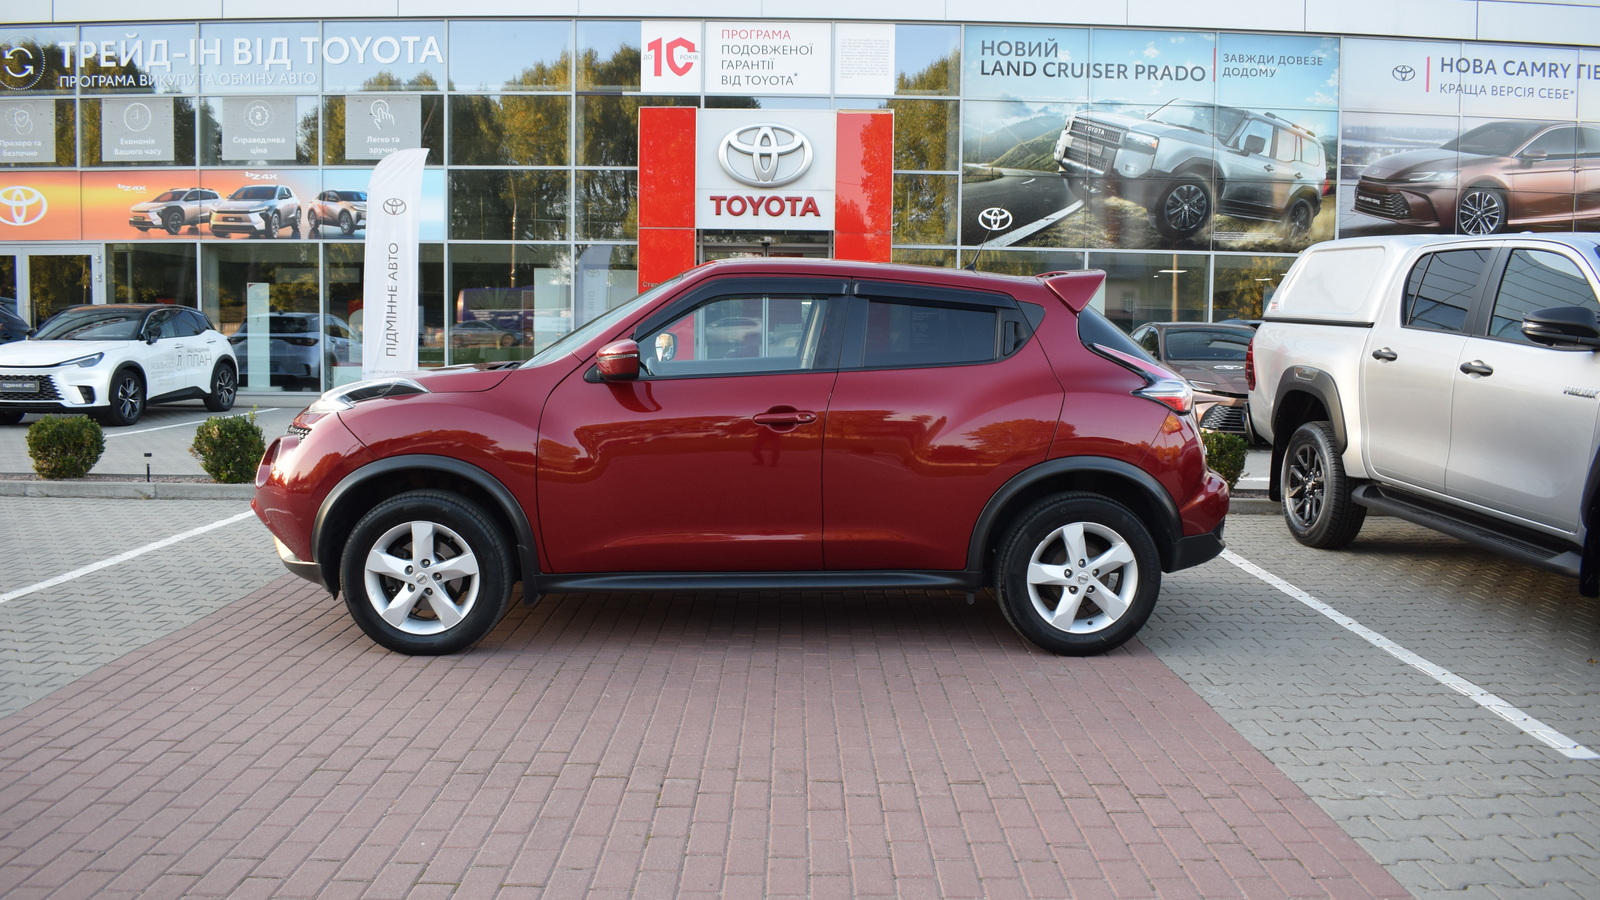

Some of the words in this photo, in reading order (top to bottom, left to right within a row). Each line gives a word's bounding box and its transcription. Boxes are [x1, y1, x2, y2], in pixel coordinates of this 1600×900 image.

[721, 29, 791, 40] ПРОГРАМА
[59, 33, 221, 72] ТРЕЙД-ІН
[234, 37, 292, 71] ВІД
[300, 36, 444, 64] TOYOTA
[721, 43, 815, 57] ПОДОВЖЕНОЇ
[980, 38, 1058, 58] НОВИЙ
[721, 58, 775, 71] ГАРАНТІЇ
[1223, 53, 1274, 66] ЗАВЖДИ
[1278, 55, 1323, 67] ДОВЕЗЕ
[980, 60, 1037, 77] LAND
[1043, 62, 1129, 80] CRUISER
[1135, 64, 1206, 82] PRADO
[1223, 67, 1277, 79] ДОДОМУ
[1440, 57, 1497, 75] НОВА
[1502, 60, 1571, 79] CAMRY
[59, 74, 136, 88] ПРОГРАМА
[140, 73, 195, 87] ВИКУПУ
[200, 73, 215, 86] ТА
[219, 72, 275, 86] ОБМІНУ
[279, 72, 317, 85] АВТО
[721, 75, 742, 87] ВІД
[1440, 83, 1487, 97] КРАЩА
[1491, 86, 1534, 98] ВЕРСІЯ
[120, 138, 155, 146] Економія
[232, 136, 286, 145] Справедлива
[366, 136, 390, 145] Легко
[114, 148, 145, 157] Вашого
[146, 149, 162, 157] часу
[250, 147, 267, 155] ціна
[709, 195, 821, 217] TOYOTA
[388, 243, 399, 281] АВТО
[386, 285, 399, 357] ПІДМІННЕ
